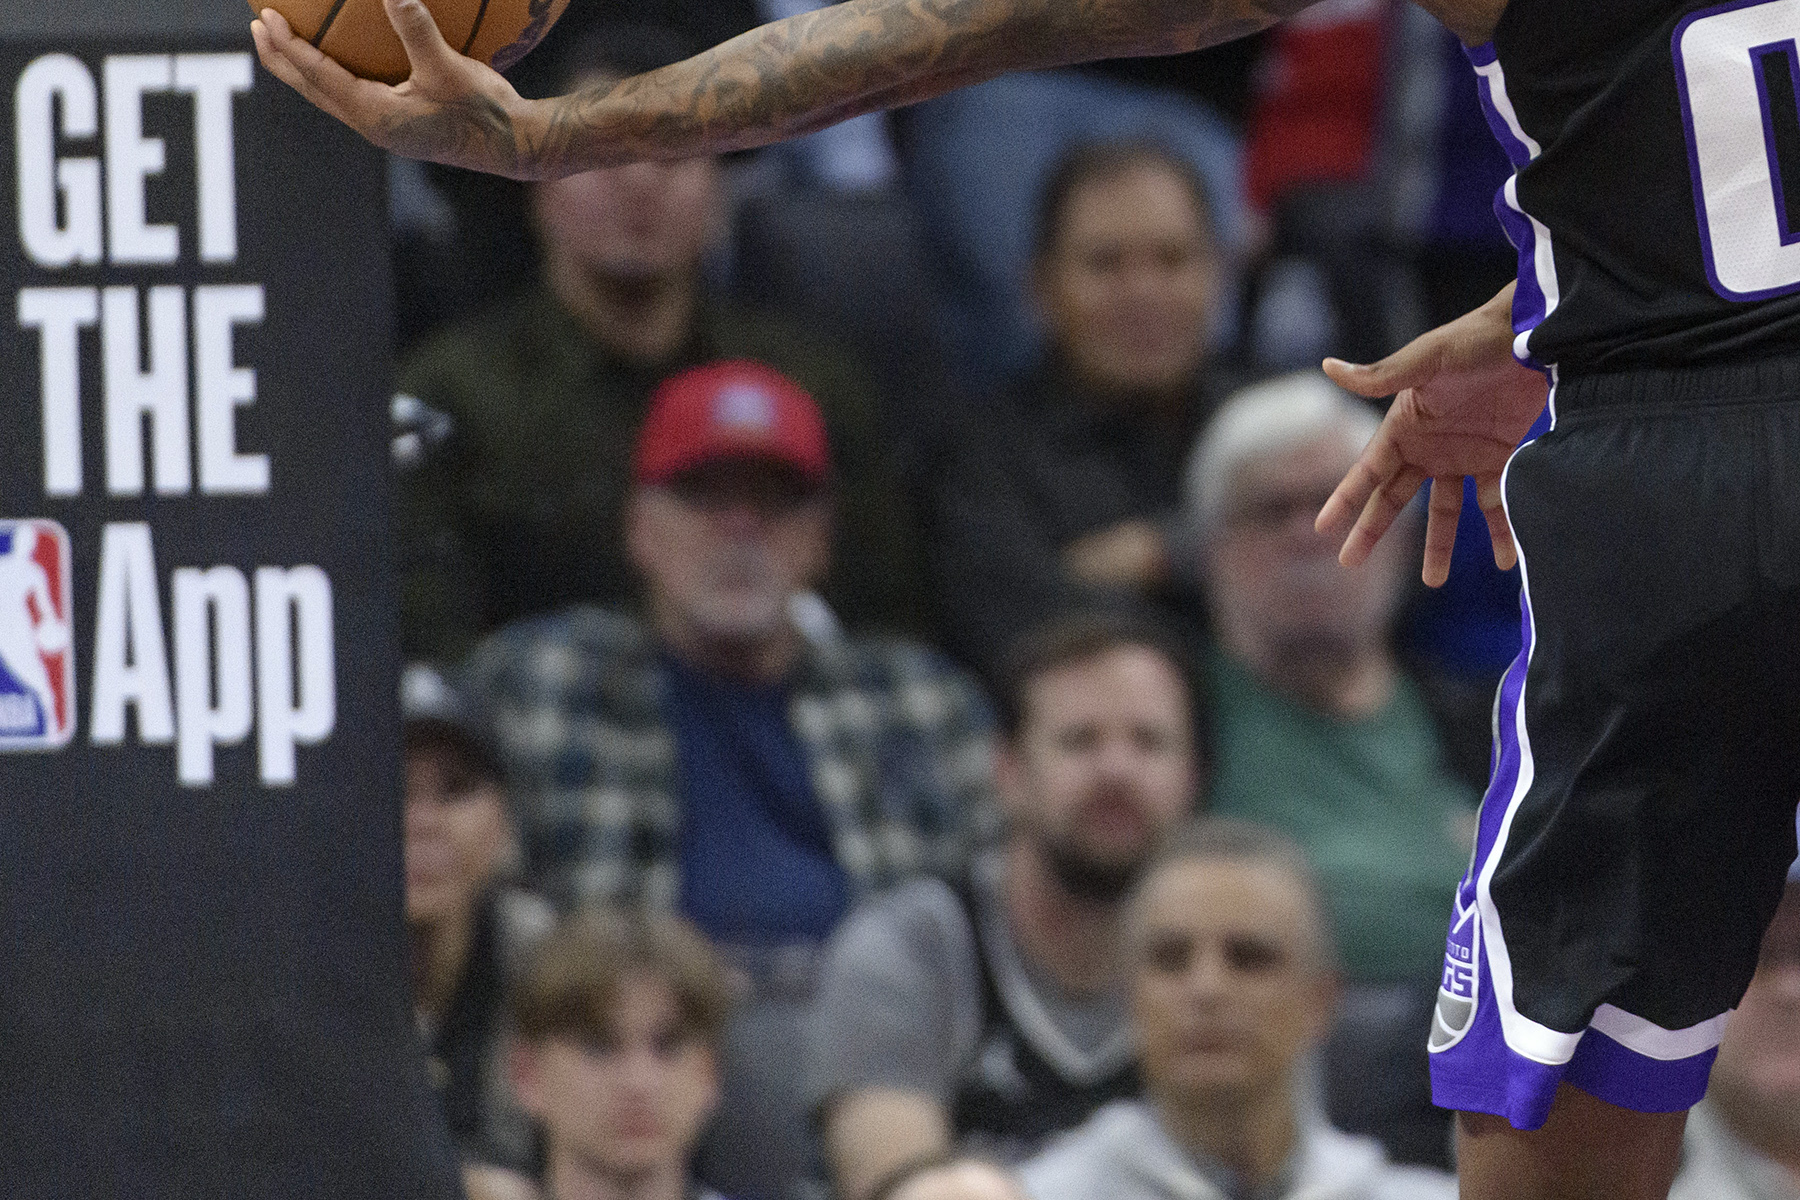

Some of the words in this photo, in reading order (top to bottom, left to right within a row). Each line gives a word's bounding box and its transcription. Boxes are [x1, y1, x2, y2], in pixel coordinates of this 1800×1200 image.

[15, 52, 254, 267] GET
[18, 284, 271, 498] THE
[90, 520, 337, 786] App
